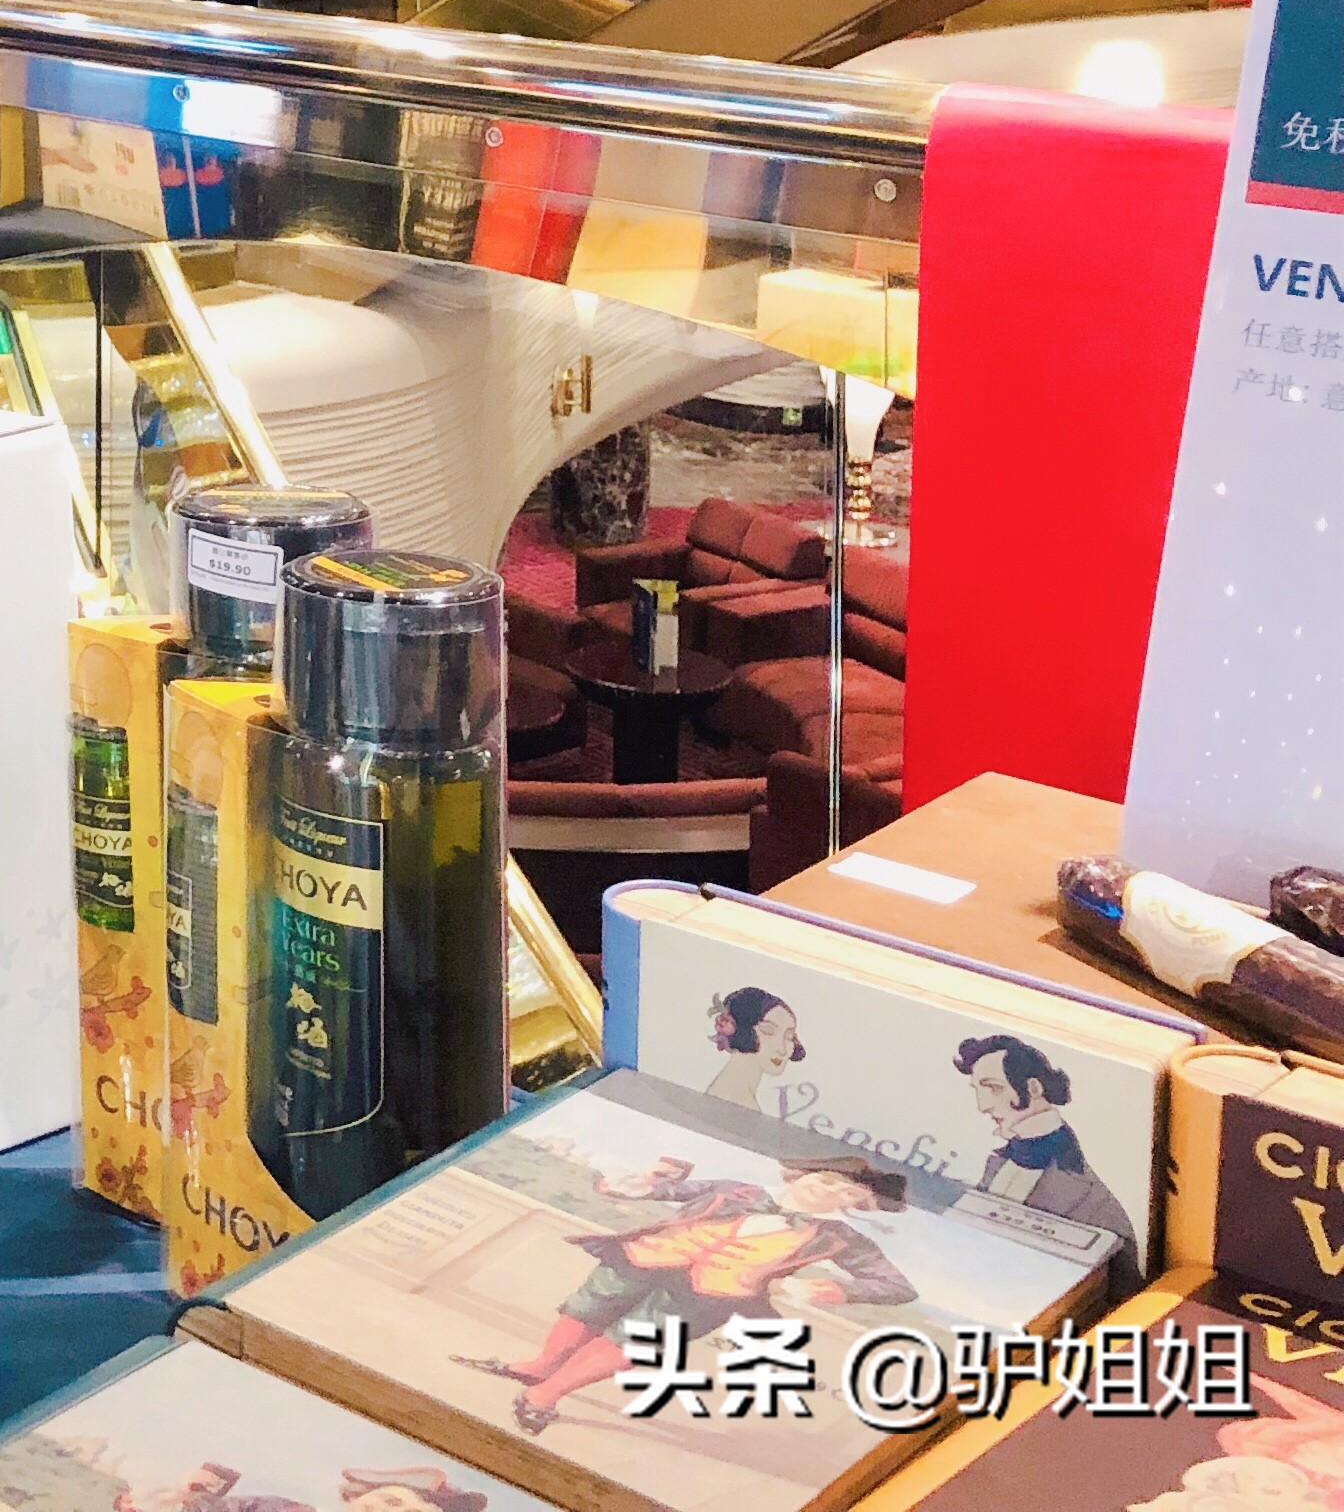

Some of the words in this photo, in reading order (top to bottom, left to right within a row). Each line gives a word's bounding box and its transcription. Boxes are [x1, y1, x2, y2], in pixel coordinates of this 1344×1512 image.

[209, 559, 251, 576] $19.90
[282, 907, 335, 947] Extra
[775, 1081, 960, 1179] Venchi
[1255, 1131, 1344, 1192] CI
